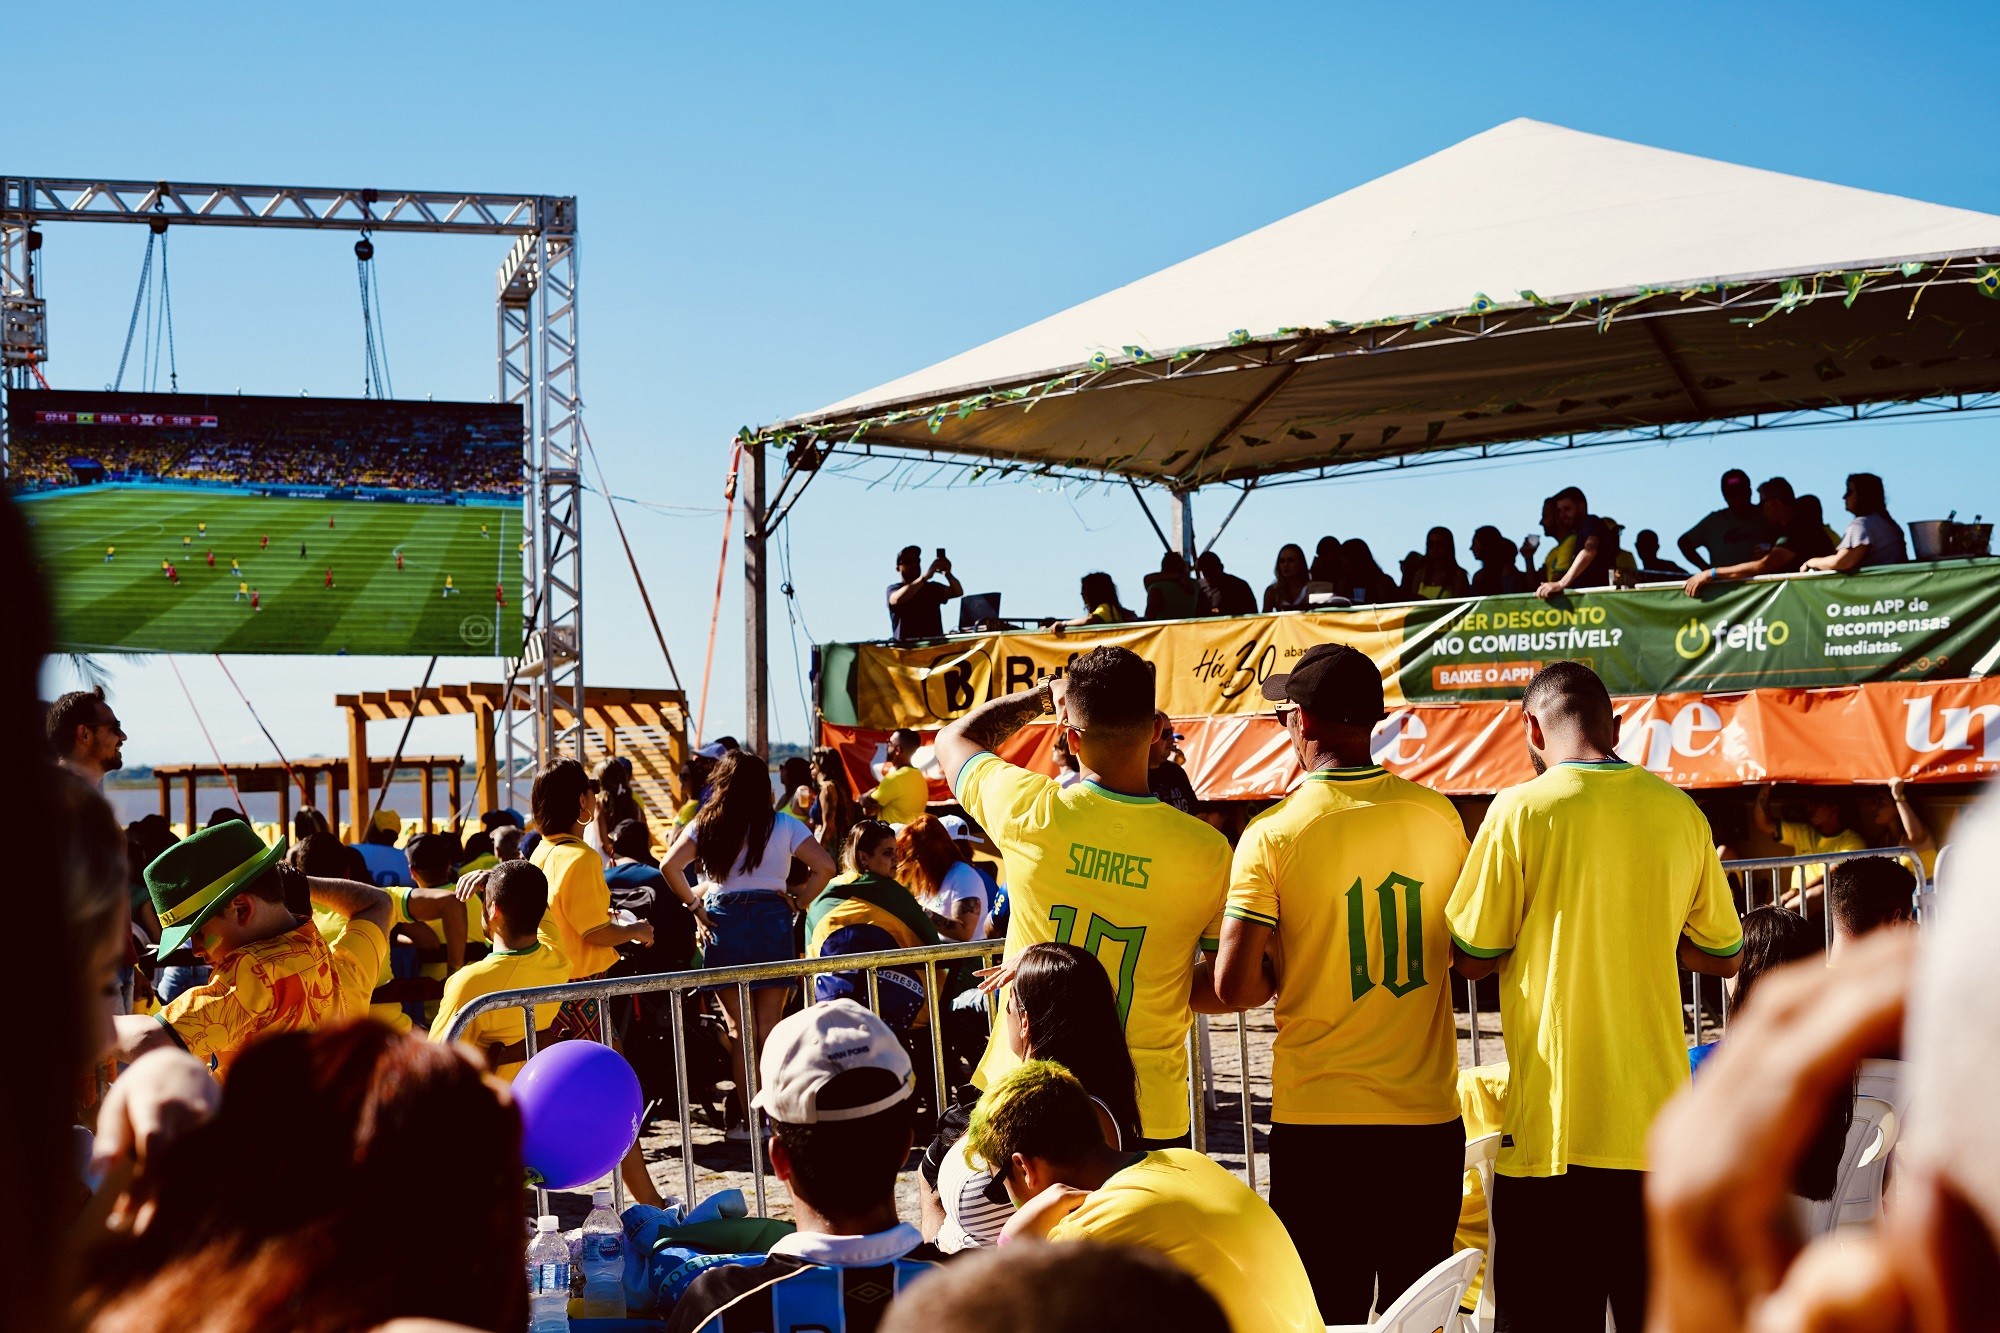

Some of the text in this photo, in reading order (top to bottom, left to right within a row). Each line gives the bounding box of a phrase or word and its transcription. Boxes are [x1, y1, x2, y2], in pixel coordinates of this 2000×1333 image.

[101, 413, 122, 424] BRA
[172, 416, 192, 426] SER
[1438, 606, 1607, 633] UER DESCONTO
[1827, 597, 1929, 618] O seu APP de
[1826, 615, 1951, 638] recompensas
[1432, 627, 1623, 656] NO COMBUSTÍVEL?
[1824, 639, 1903, 657] imediatas.
[1193, 648, 1228, 684] Há
[1221, 640, 1277, 699] 30
[1440, 669, 1483, 685] BAIXE
[1485, 668, 1499, 683] O
[1612, 702, 1723, 772] ne
[1903, 694, 2000, 763] un
[1664, 772, 1700, 782] NDE
[1957, 762, 2000, 774] GRA
[1065, 842, 1152, 890] SOARES
[1344, 870, 1429, 1001] 10
[877, 968, 924, 995] OGRESSO
